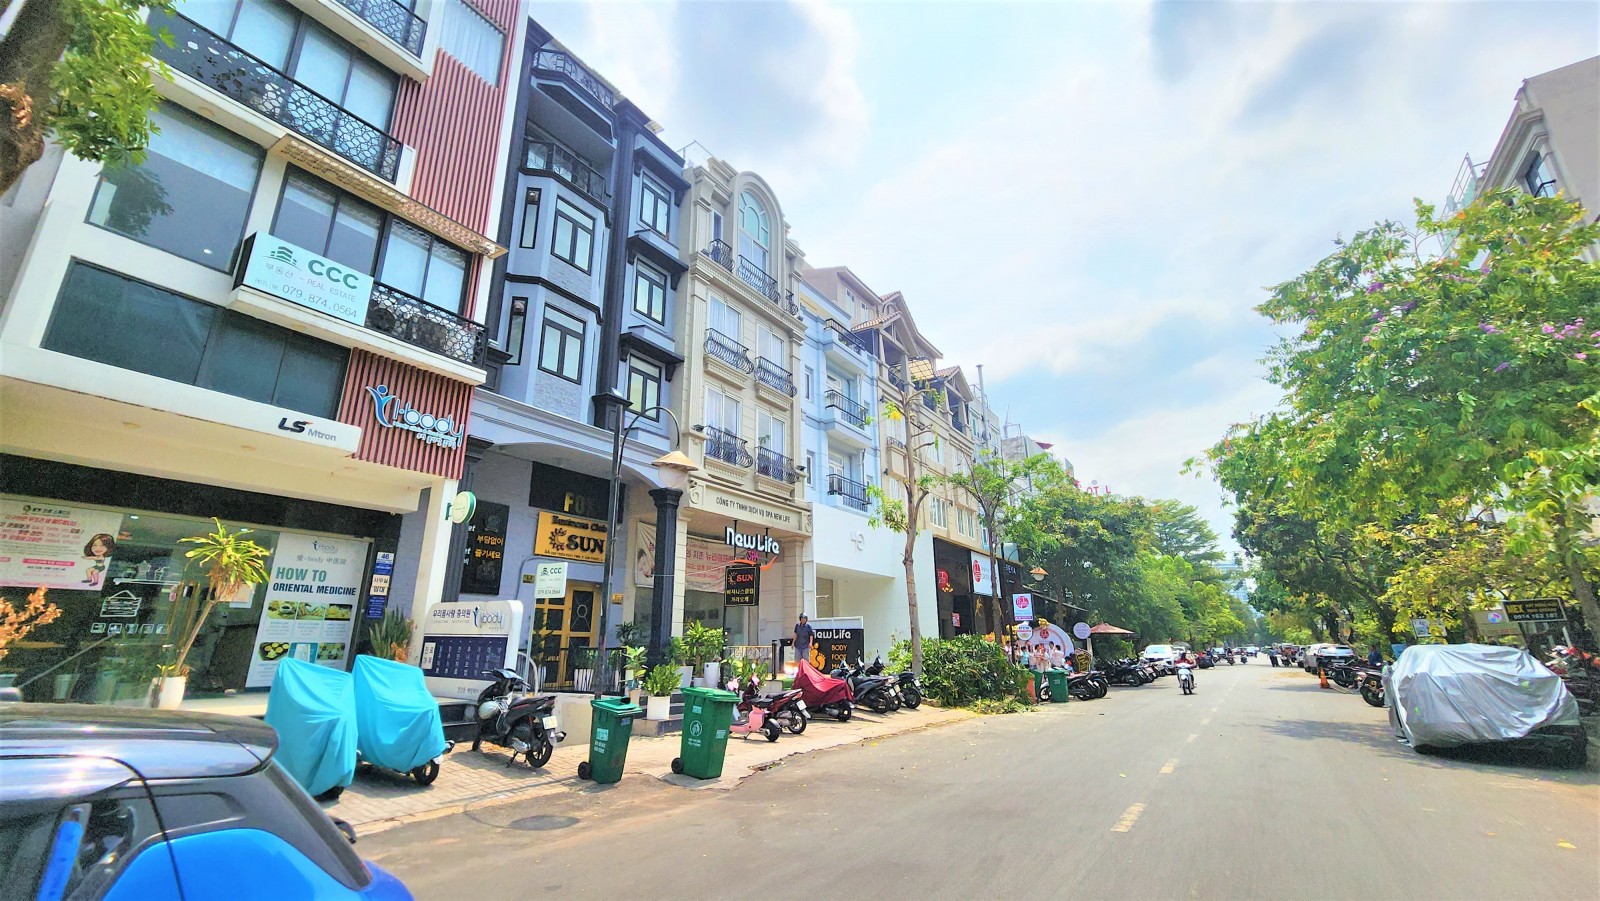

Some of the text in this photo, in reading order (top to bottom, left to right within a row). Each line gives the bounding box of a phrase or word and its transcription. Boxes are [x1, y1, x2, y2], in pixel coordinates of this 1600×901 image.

[307, 259, 359, 290] CCC
[307, 278, 325, 292] REAL
[329, 287, 357, 302] ESTATE
[277, 417, 337, 443] LS Mtron
[765, 510, 773, 518] SPA
[773, 512, 783, 521] NEW
[783, 514, 791, 523] LIFE
[566, 534, 605, 555] SUN
[275, 566, 328, 583] HOW TO
[549, 567, 562, 575] CCC
[736, 573, 754, 583] SUN
[272, 582, 357, 596] ORIENTAL MEDICINE
[831, 653, 847, 661] FOOT
